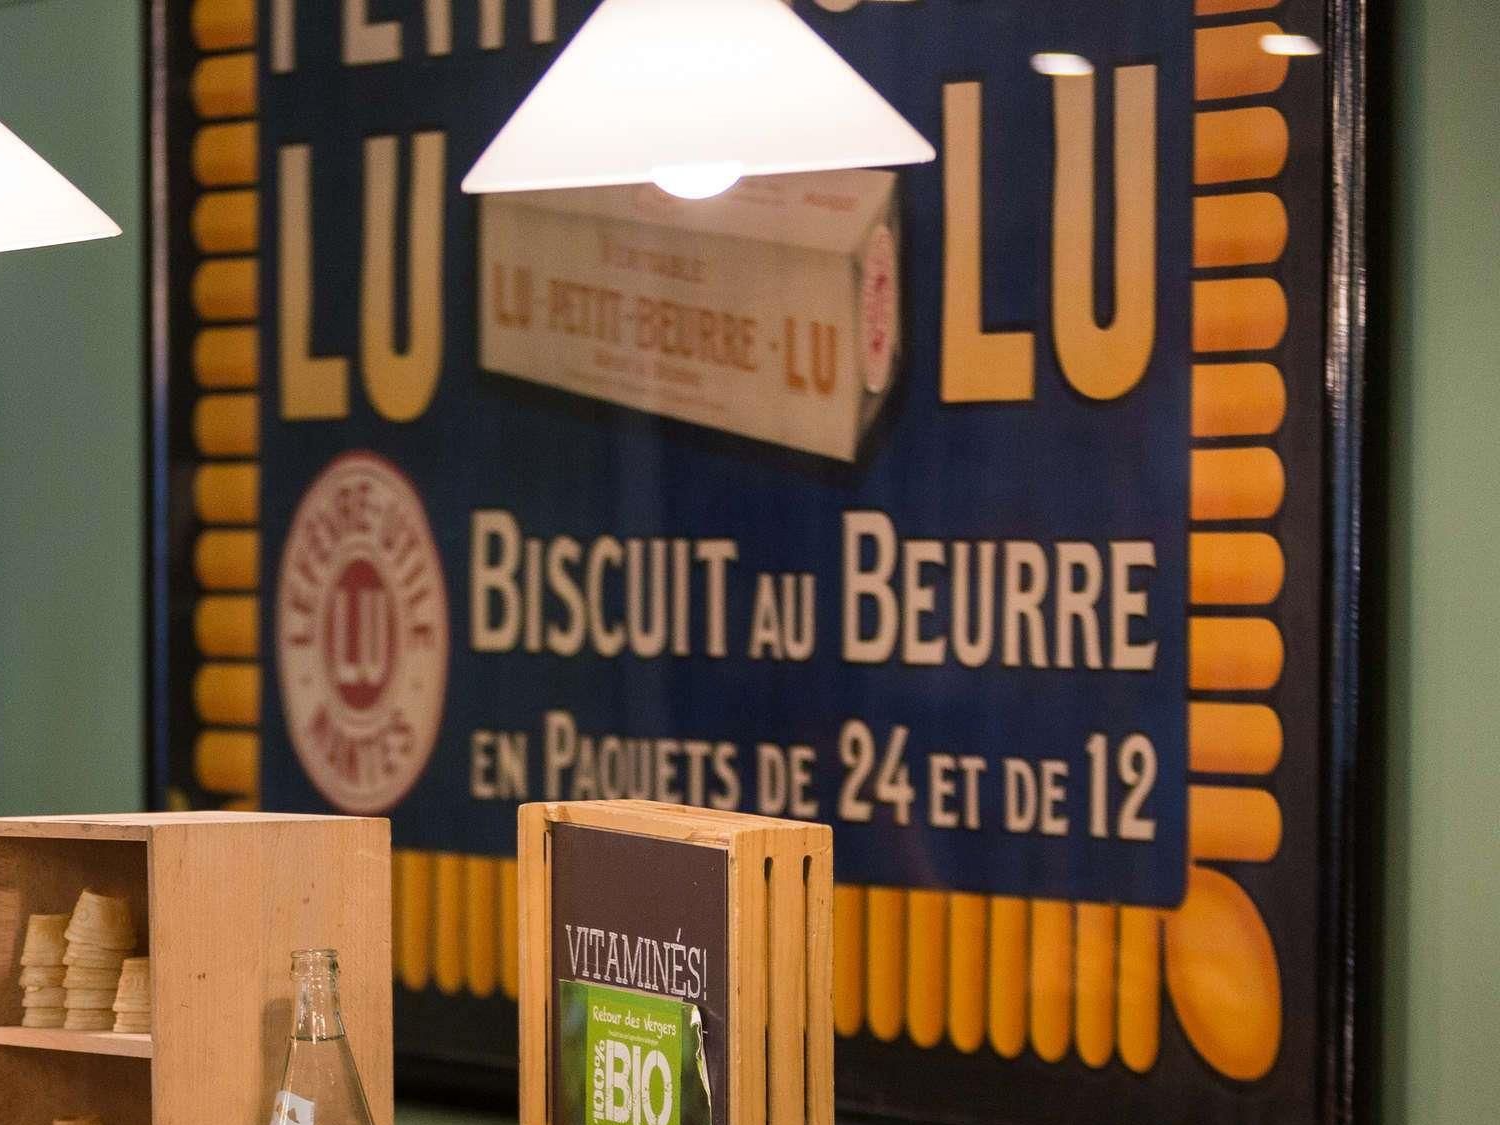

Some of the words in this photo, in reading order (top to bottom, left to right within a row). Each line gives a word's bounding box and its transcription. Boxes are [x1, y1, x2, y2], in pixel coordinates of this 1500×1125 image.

[278, 129, 446, 422] LU
[941, 64, 1158, 403] LU
[783, 315, 838, 396] LU
[471, 508, 739, 658] BISCUIT
[750, 573, 816, 662] AU
[842, 509, 1159, 670] BEURRE
[471, 730, 528, 798] EN
[757, 741, 818, 821] DE
[838, 718, 915, 827] 24
[929, 753, 987, 829] ET
[1004, 757, 1070, 836] DE
[1085, 732, 1159, 841] 12
[593, 1006, 622, 1025] Retour
[625, 1010, 640, 1029] des
[644, 1013, 676, 1040] Vergers
[594, 1039, 605, 1124] 100%
